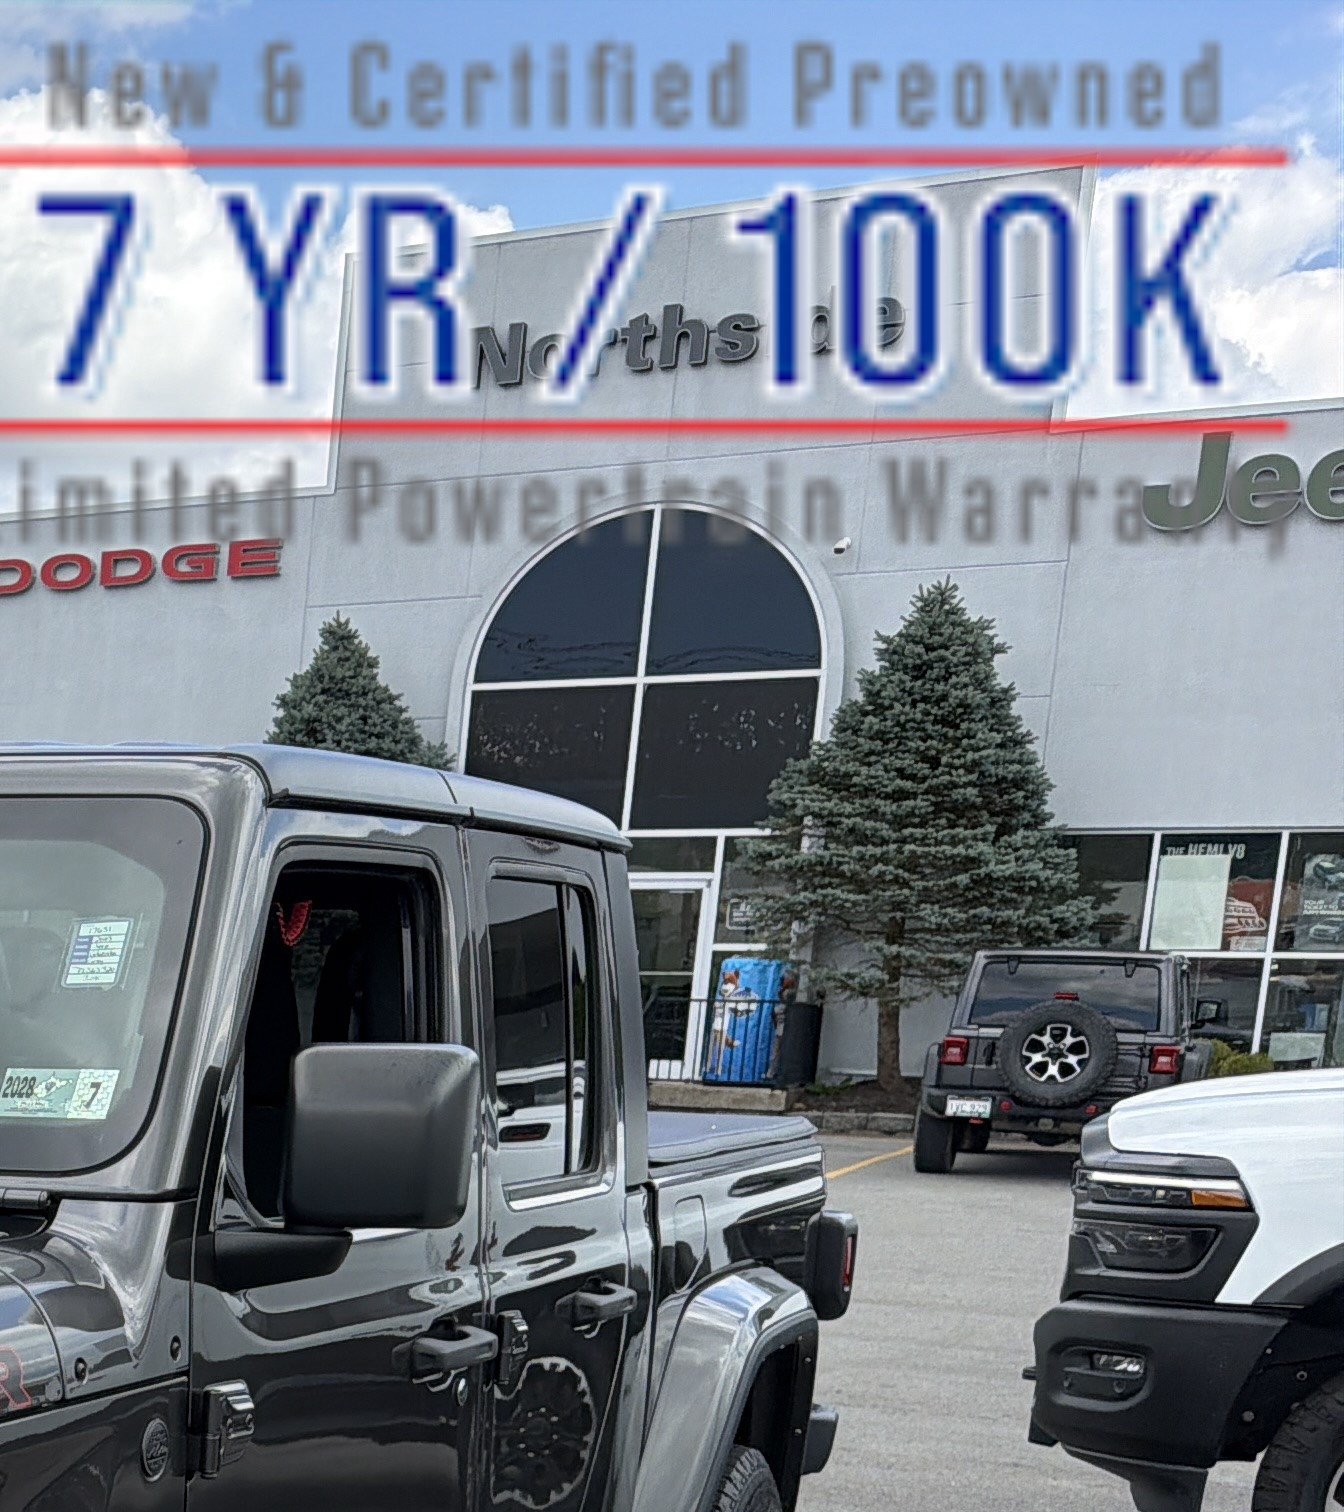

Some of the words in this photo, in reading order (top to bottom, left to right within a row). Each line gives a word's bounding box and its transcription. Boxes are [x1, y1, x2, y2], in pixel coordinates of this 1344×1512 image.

[471, 285, 907, 388] Northsde
[1141, 430, 1344, 533] Jee
[1227, 843, 1246, 860] V8
[2, 1075, 37, 1099] 2028
[84, 1081, 103, 1109] 7
